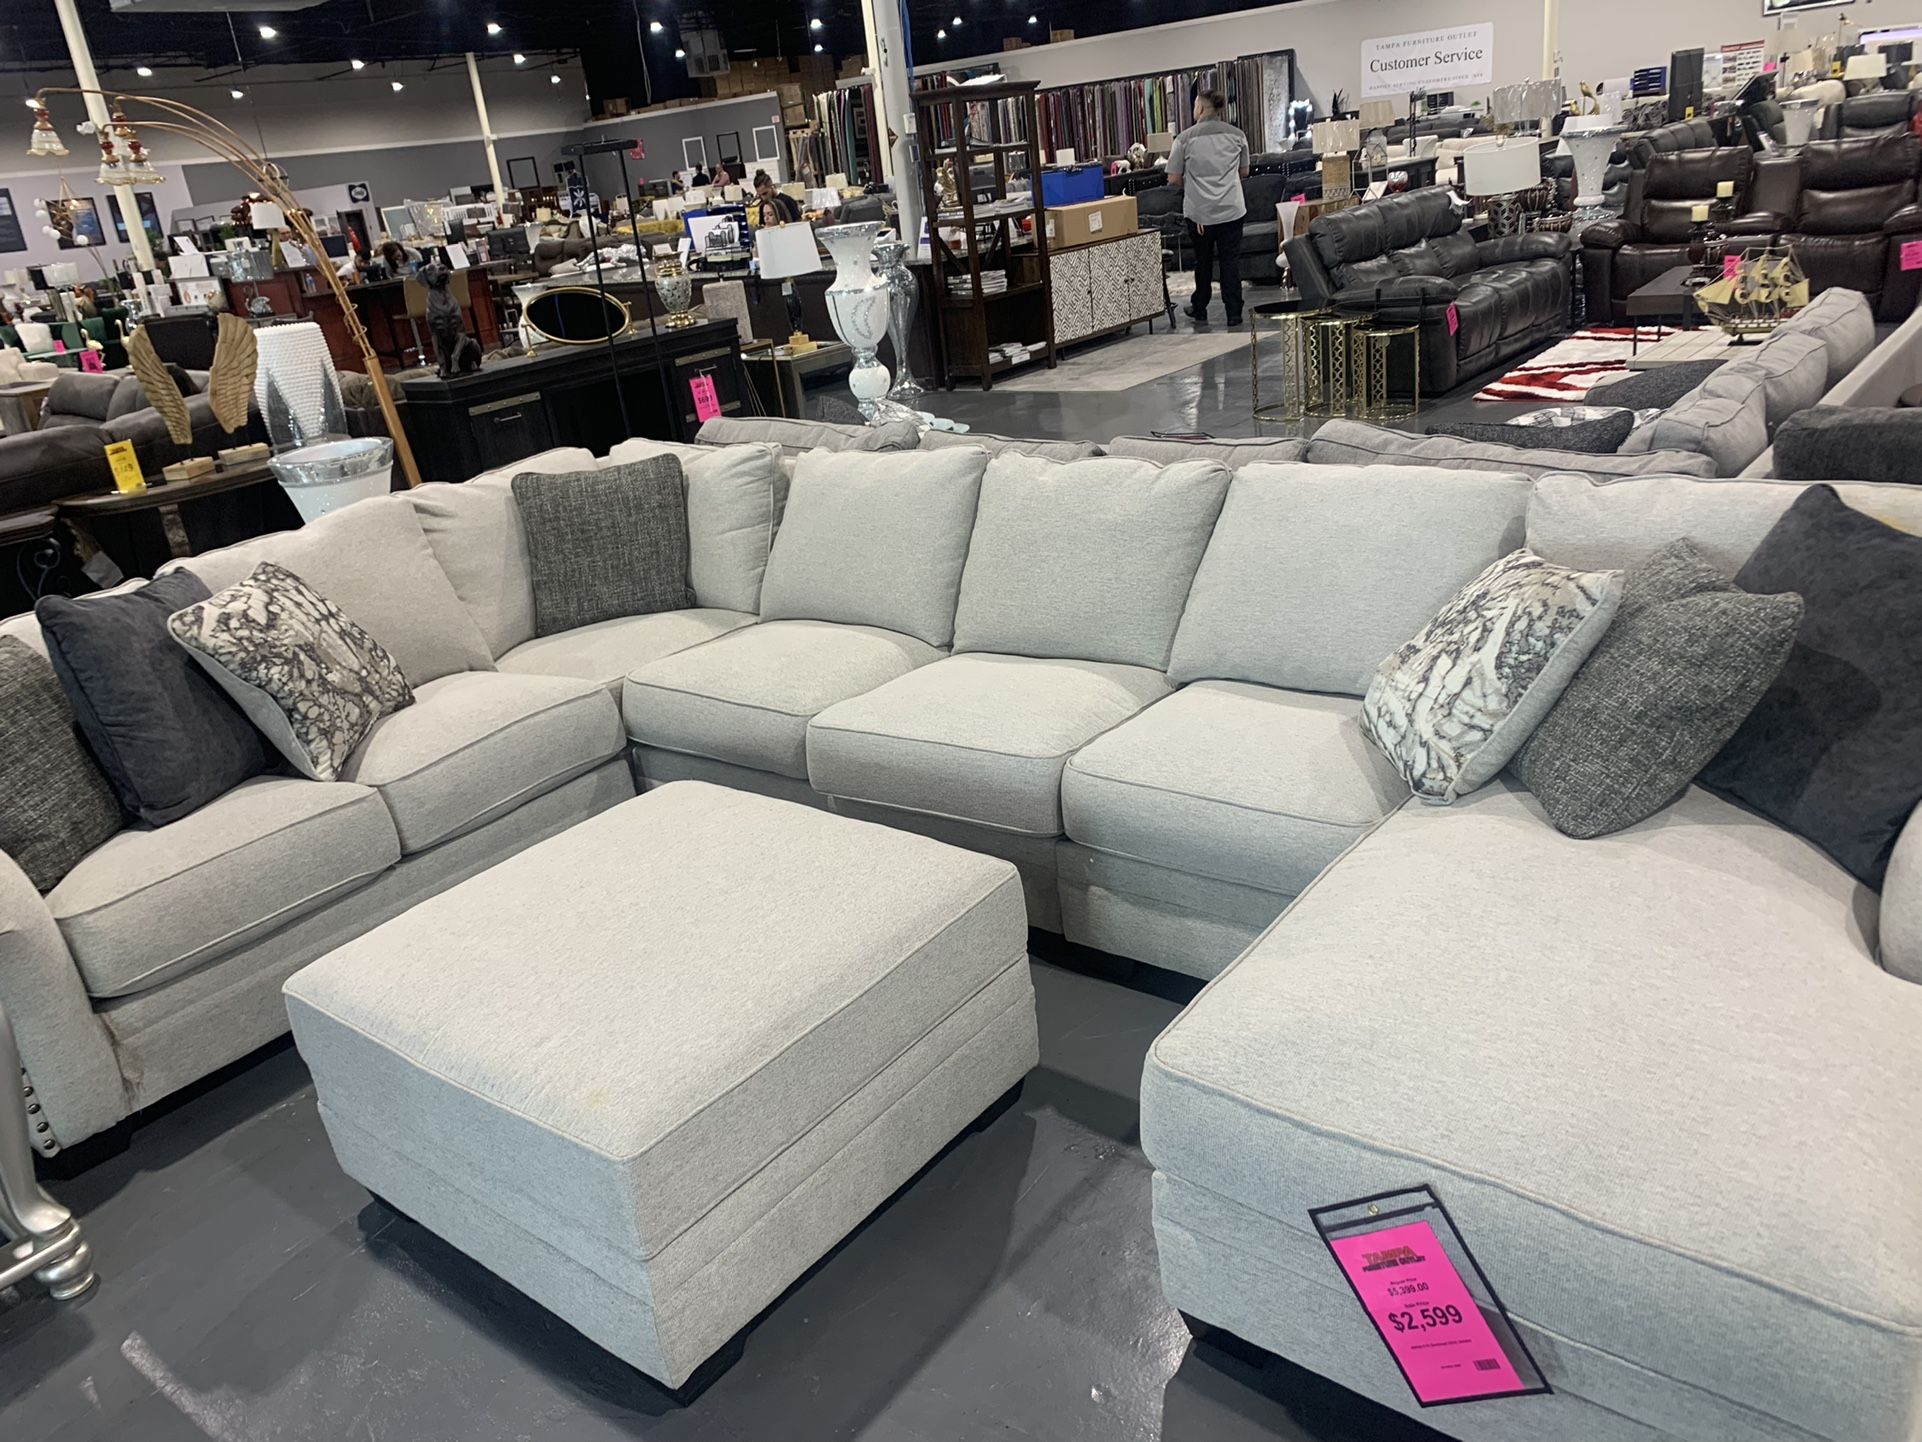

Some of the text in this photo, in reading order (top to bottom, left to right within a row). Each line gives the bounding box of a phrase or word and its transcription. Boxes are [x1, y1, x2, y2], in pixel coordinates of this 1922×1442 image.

[1376, 31, 1478, 51] TAMPA FURNITURE OUTLET
[1370, 47, 1483, 73] Customer Service
[1388, 1304, 1463, 1333] $2,599
